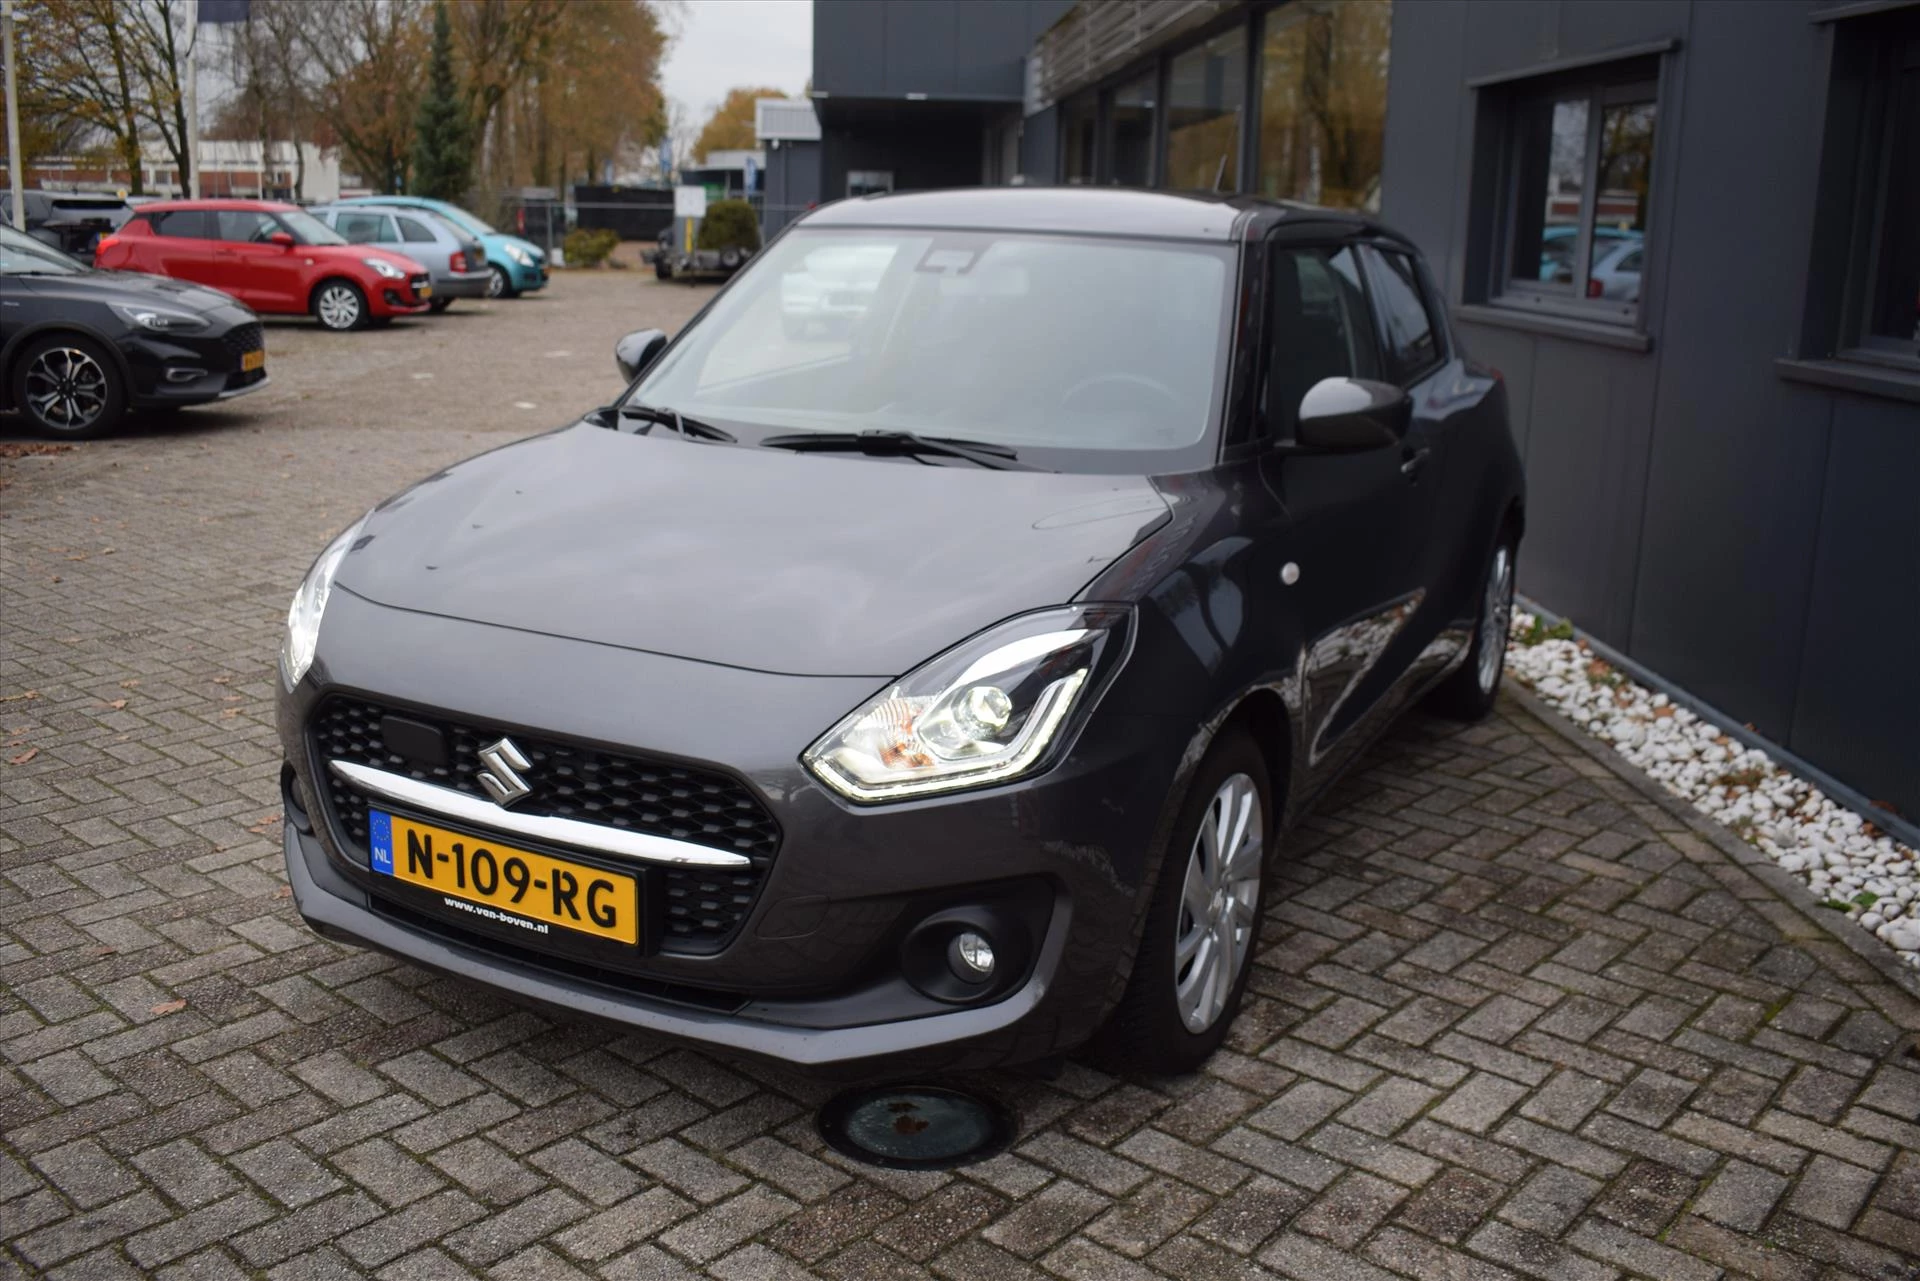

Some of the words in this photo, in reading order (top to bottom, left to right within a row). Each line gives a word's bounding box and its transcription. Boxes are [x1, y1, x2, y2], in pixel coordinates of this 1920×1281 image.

[374, 846, 391, 865] NL
[406, 828, 617, 928] N-109-RG
[444, 897, 549, 934] www.van-boven.nl
